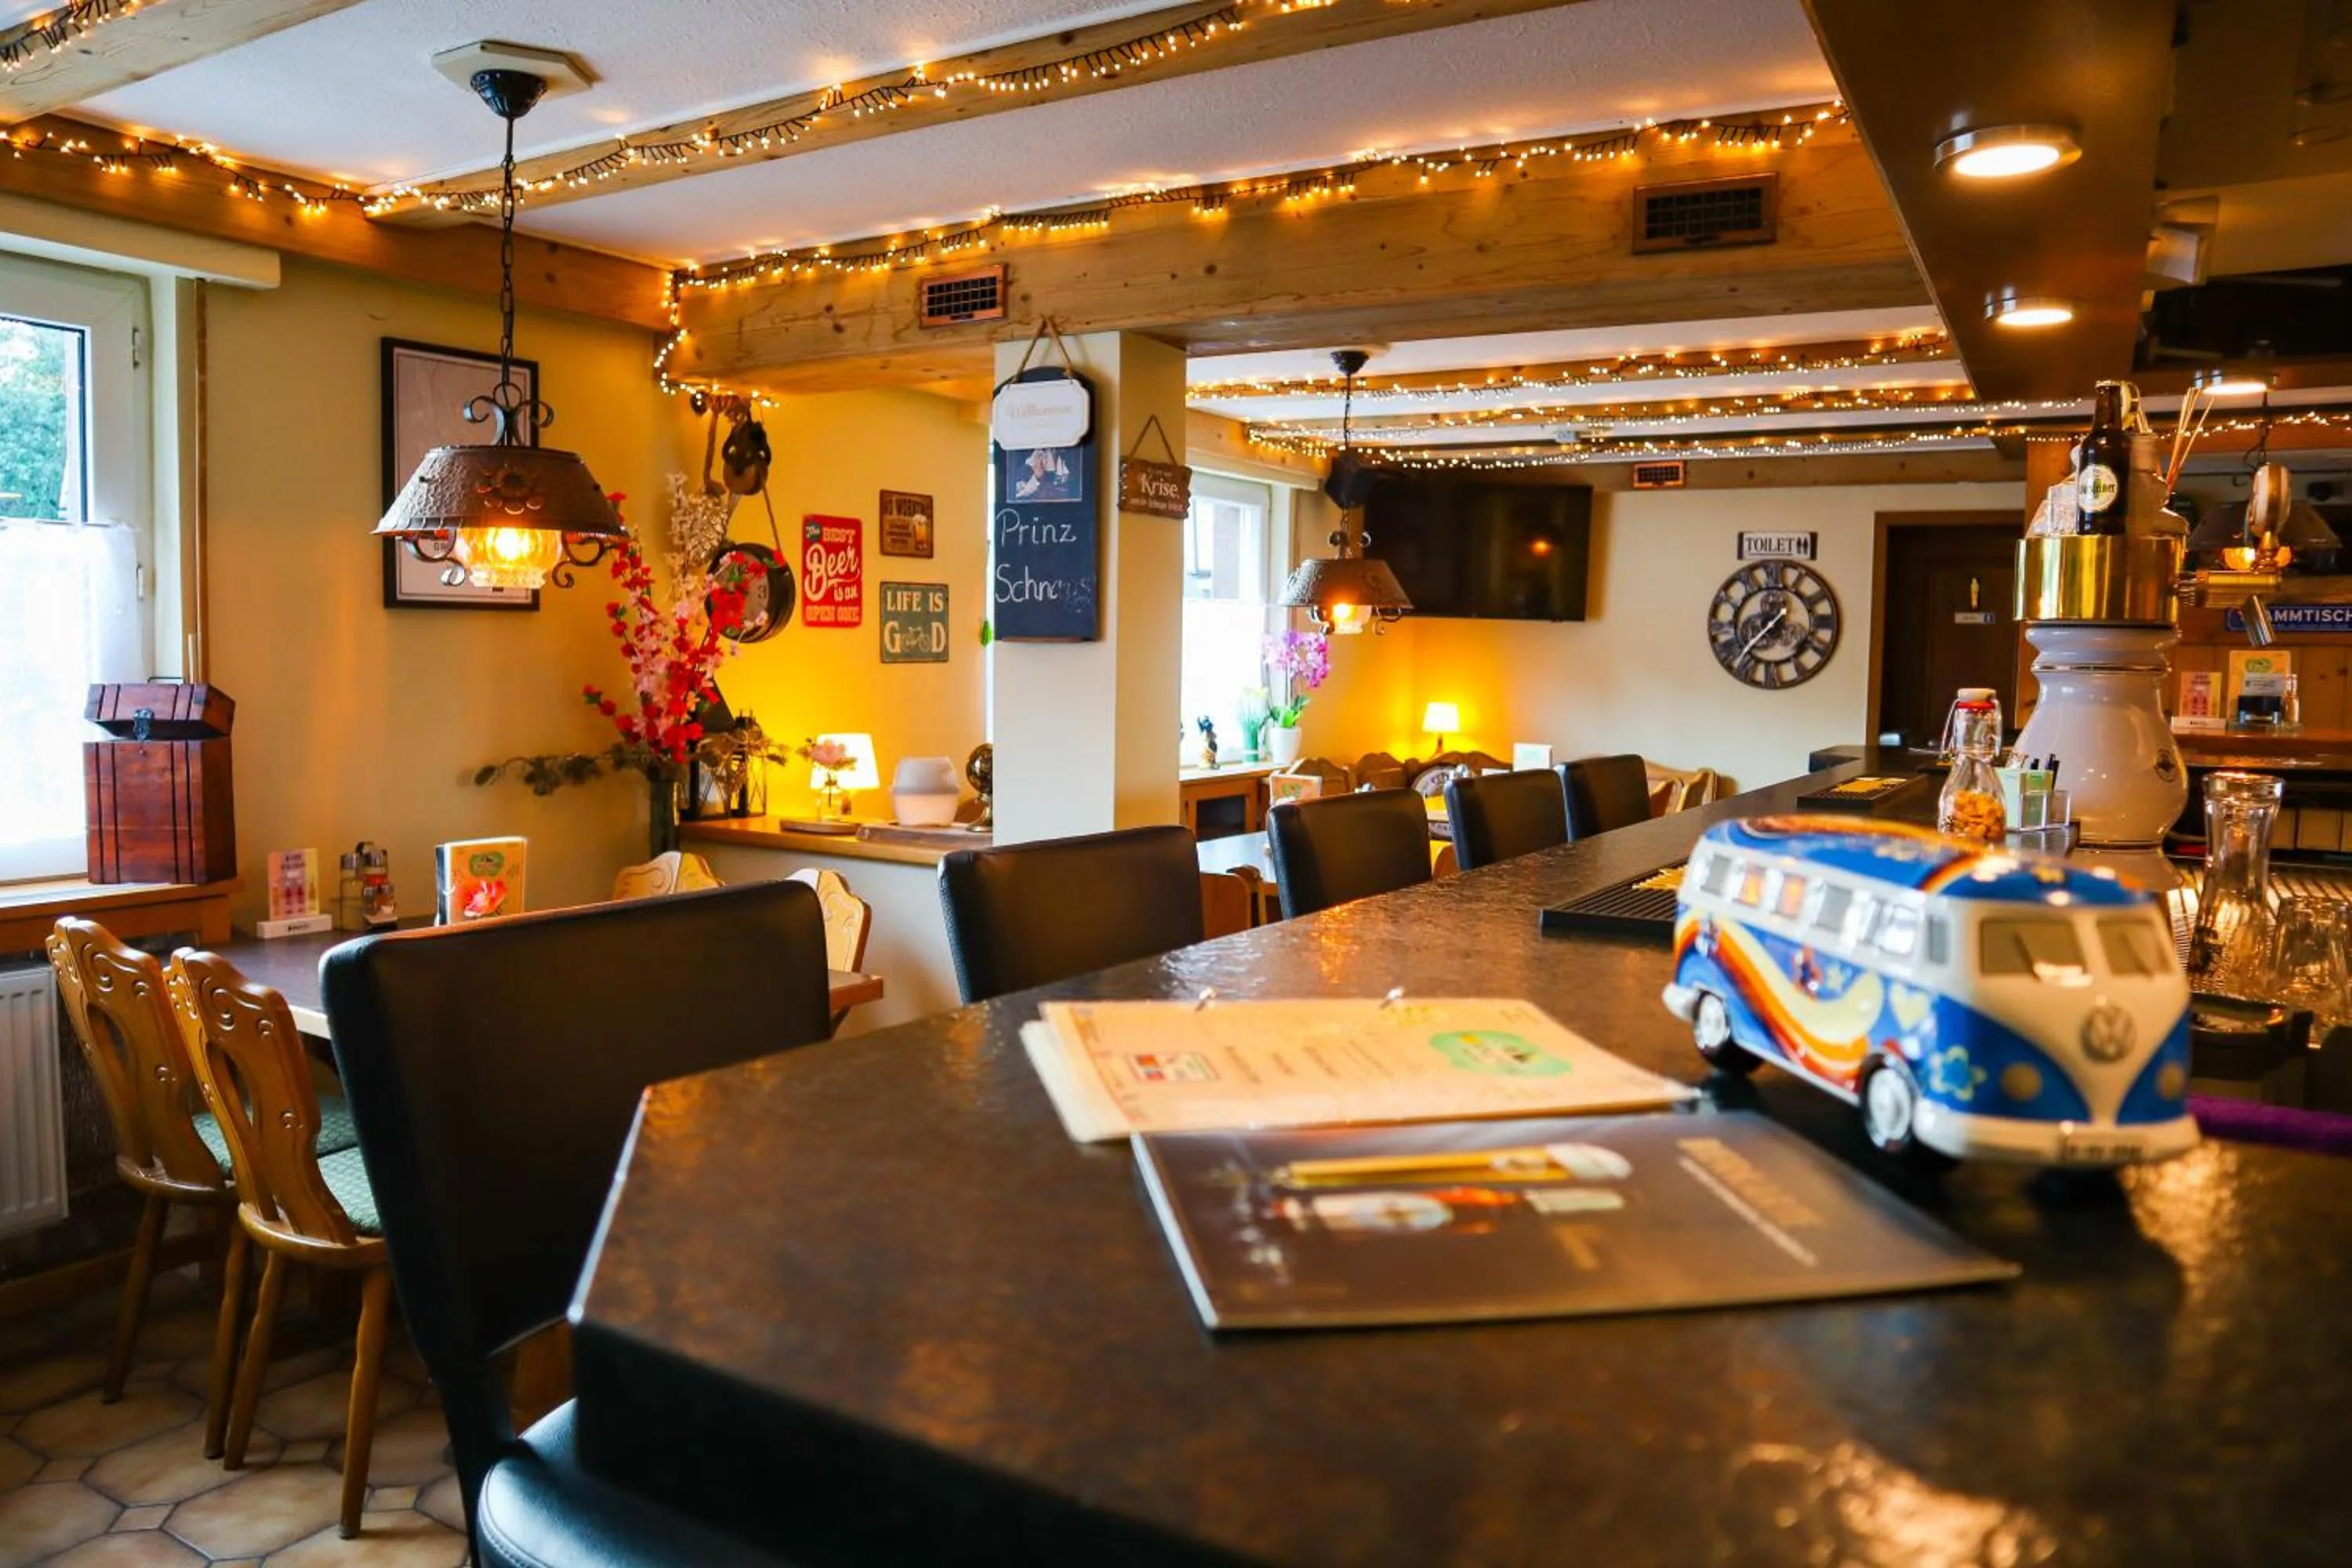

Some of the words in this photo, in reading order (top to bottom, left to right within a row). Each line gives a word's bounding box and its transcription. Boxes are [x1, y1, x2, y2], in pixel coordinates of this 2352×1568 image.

[823, 527, 856, 543] BEST
[996, 508, 1076, 546] Prinz
[1745, 537, 1795, 553] TOILET
[804, 543, 860, 601] Beer
[833, 584, 844, 602] is
[844, 585, 858, 601] an
[886, 590, 922, 612] LIFE
[928, 591, 944, 612] IS
[805, 605, 836, 622] OPEN
[837, 606, 860, 622] ONE
